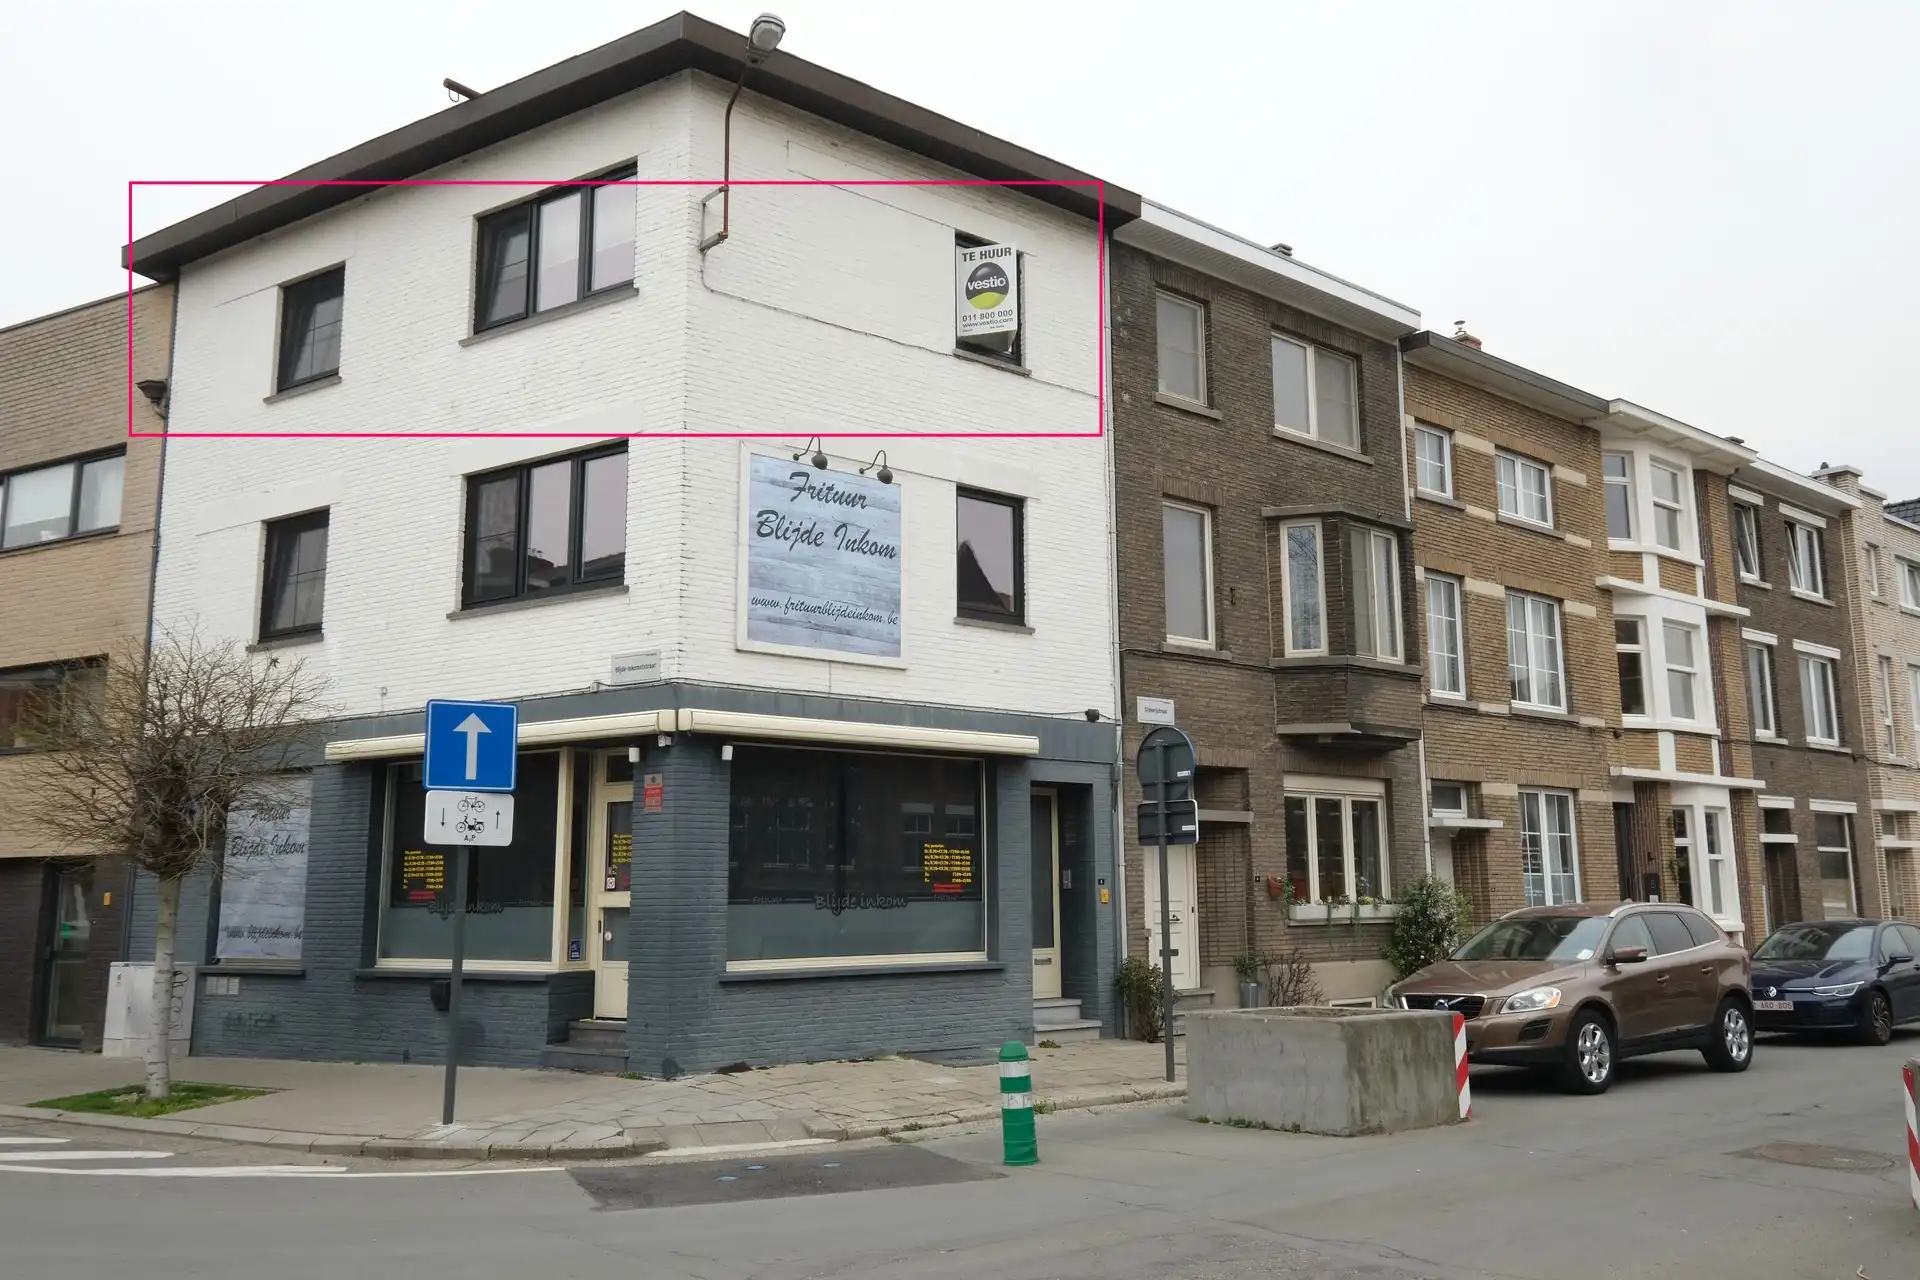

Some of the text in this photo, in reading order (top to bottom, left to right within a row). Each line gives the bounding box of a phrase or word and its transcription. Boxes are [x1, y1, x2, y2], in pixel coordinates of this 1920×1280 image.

[962, 247, 1012, 262] TE HUUR
[967, 276, 1006, 290] vestio
[962, 309, 1013, 322] 011 800 000
[962, 318, 1014, 328] www.vestio.com
[789, 471, 868, 509] Frituur
[756, 509, 896, 559] Blijde Inkom
[814, 894, 857, 916] Blijde
[860, 893, 908, 910] inkom
